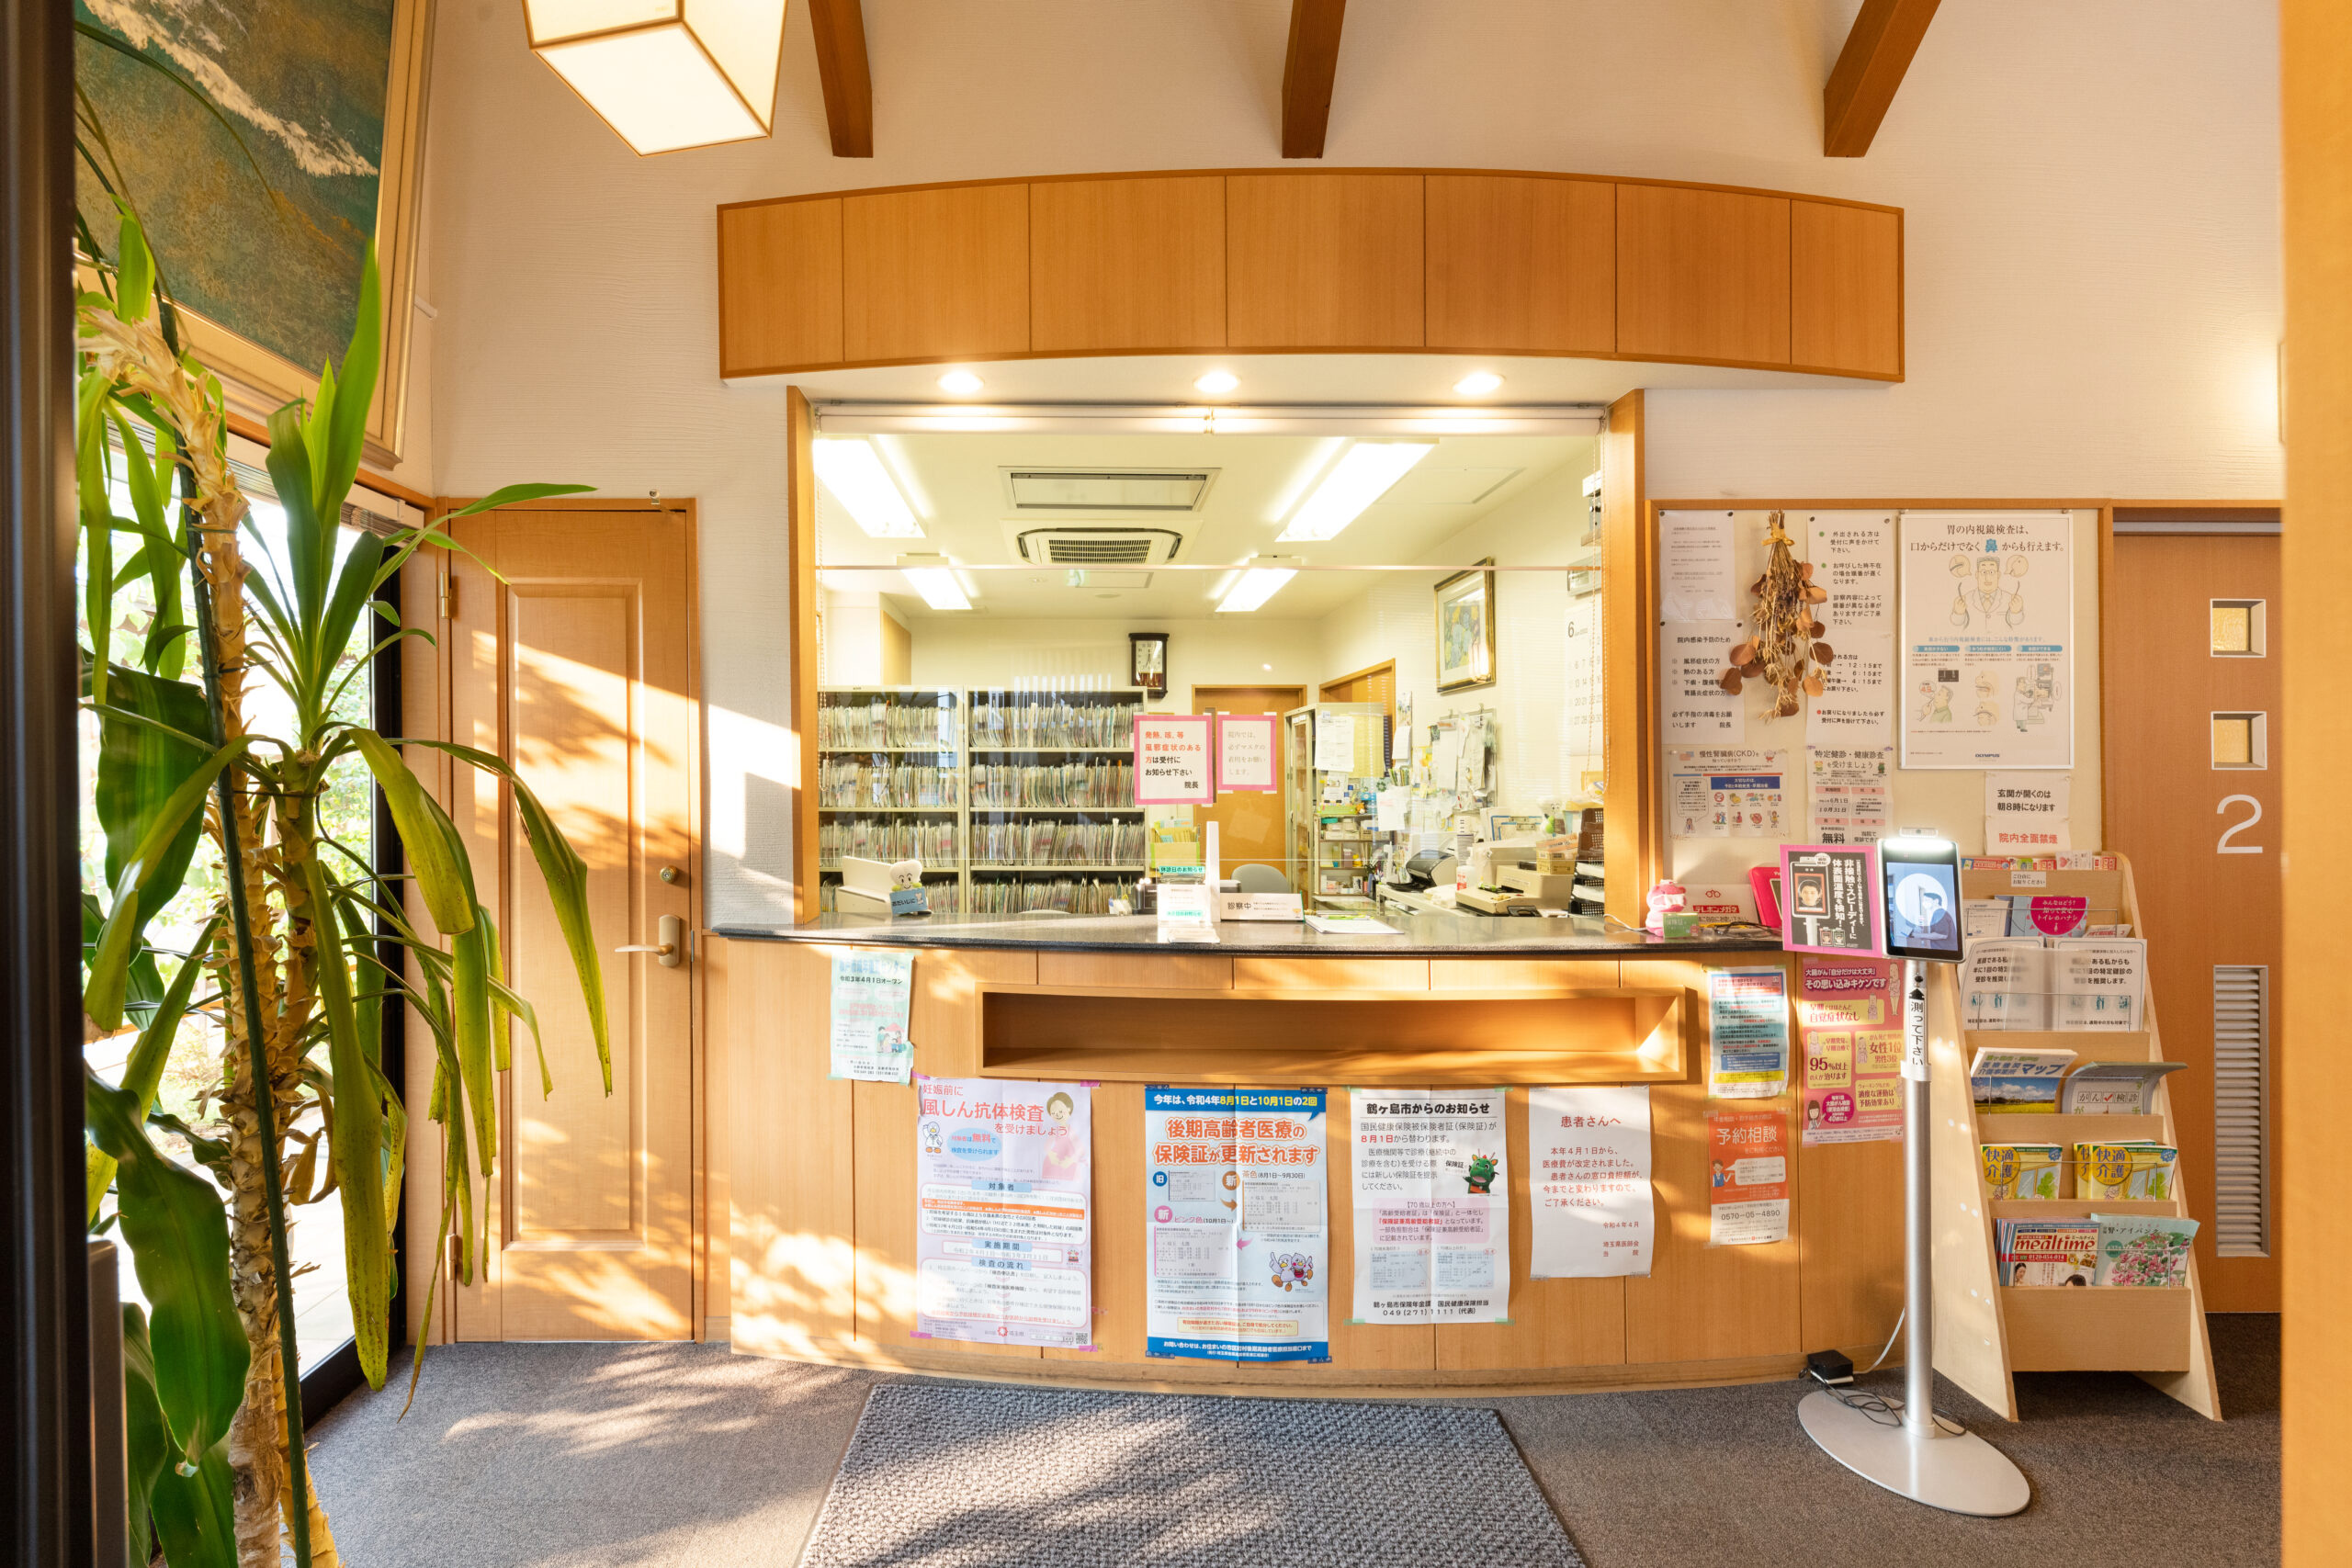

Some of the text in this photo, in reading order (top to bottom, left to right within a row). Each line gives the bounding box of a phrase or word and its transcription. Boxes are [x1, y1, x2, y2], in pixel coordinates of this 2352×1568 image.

[1947, 525, 2030, 535] 胃の内視鏡検査は、
[1910, 538, 2064, 553] 口からだけでなく 鼻 からも行えます。
[1567, 621, 1575, 637] 6
[1145, 743, 1201, 751] 風邪症状のある
[1815, 750, 1884, 759] 特定健診・健康診査
[1145, 768, 1193, 776] お知らせ下さい
[1184, 781, 1199, 789] 院長
[1997, 788, 2052, 798] 玄関が開くのは
[1997, 802, 2056, 812] 朝8時になります
[2217, 795, 2263, 853] 2
[1822, 832, 1845, 844] 無料
[1998, 832, 2058, 844] 院内全面禁煙
[1843, 859, 1858, 940] 非接触でスピーディーに
[1227, 902, 1252, 910] 診察中
[1805, 967, 1877, 977] 大腸がん「自分だけは大丈夫」
[1804, 977, 1886, 990] その思い込みキケンです
[1809, 1010, 1860, 1023] 自覚症状なし
[1910, 1001, 1925, 1066] 測って下さい
[1869, 1042, 1903, 1055] 女性1位
[1809, 1057, 1849, 1071] 95%以上
[2020, 1063, 2065, 1075] マップ
[922, 1084, 964, 1096] 妊娠前に
[1154, 1095, 1317, 1107] 今年は、令和4年8月1日と10月1日の2回
[1860, 1098, 1894, 1108] 予防効果あり
[922, 1099, 1044, 1122] 風しん抗体検査
[1366, 1103, 1490, 1115] 鶴ヶ島市からのお知らせ
[1361, 1122, 1497, 1132] 国民健康保険被保険者証(保険証)が
[1560, 1115, 1622, 1128] 患者さんへ
[994, 1123, 1068, 1136] を受けましょう
[1167, 1118, 1305, 1139] 後期高齢者医療の
[1715, 1125, 1778, 1145] 予約相談
[951, 1147, 999, 1156] 検査を受けられます
[1154, 1144, 1318, 1164] 保険証が更新されます
[1550, 1147, 1618, 1156] 本年4月1日から、
[1985, 1146, 2126, 1163] 快適 快適
[1445, 1159, 1464, 1168] 保険証
[1542, 1158, 1634, 1168] 医療費が改定されました。
[1156, 1174, 1164, 1183] 旧
[1226, 1175, 1237, 1187] 新
[1362, 1171, 1438, 1179] には新しい保険証を提示
[1550, 1171, 1643, 1180] 患者さんの窓口負担額が、
[1362, 1182, 1404, 1190] してください。
[1543, 1184, 1636, 1194] 今までと変わりますので、
[1544, 1198, 1605, 1207] ご了承ください。
[1158, 1209, 1170, 1221] 新
[1721, 1209, 1781, 1221] 0570-05-4890
[984, 1241, 1020, 1250] 実施期間
[2014, 1235, 2096, 1250] mealtime
[978, 1258, 1023, 1269] 検査の流れ
